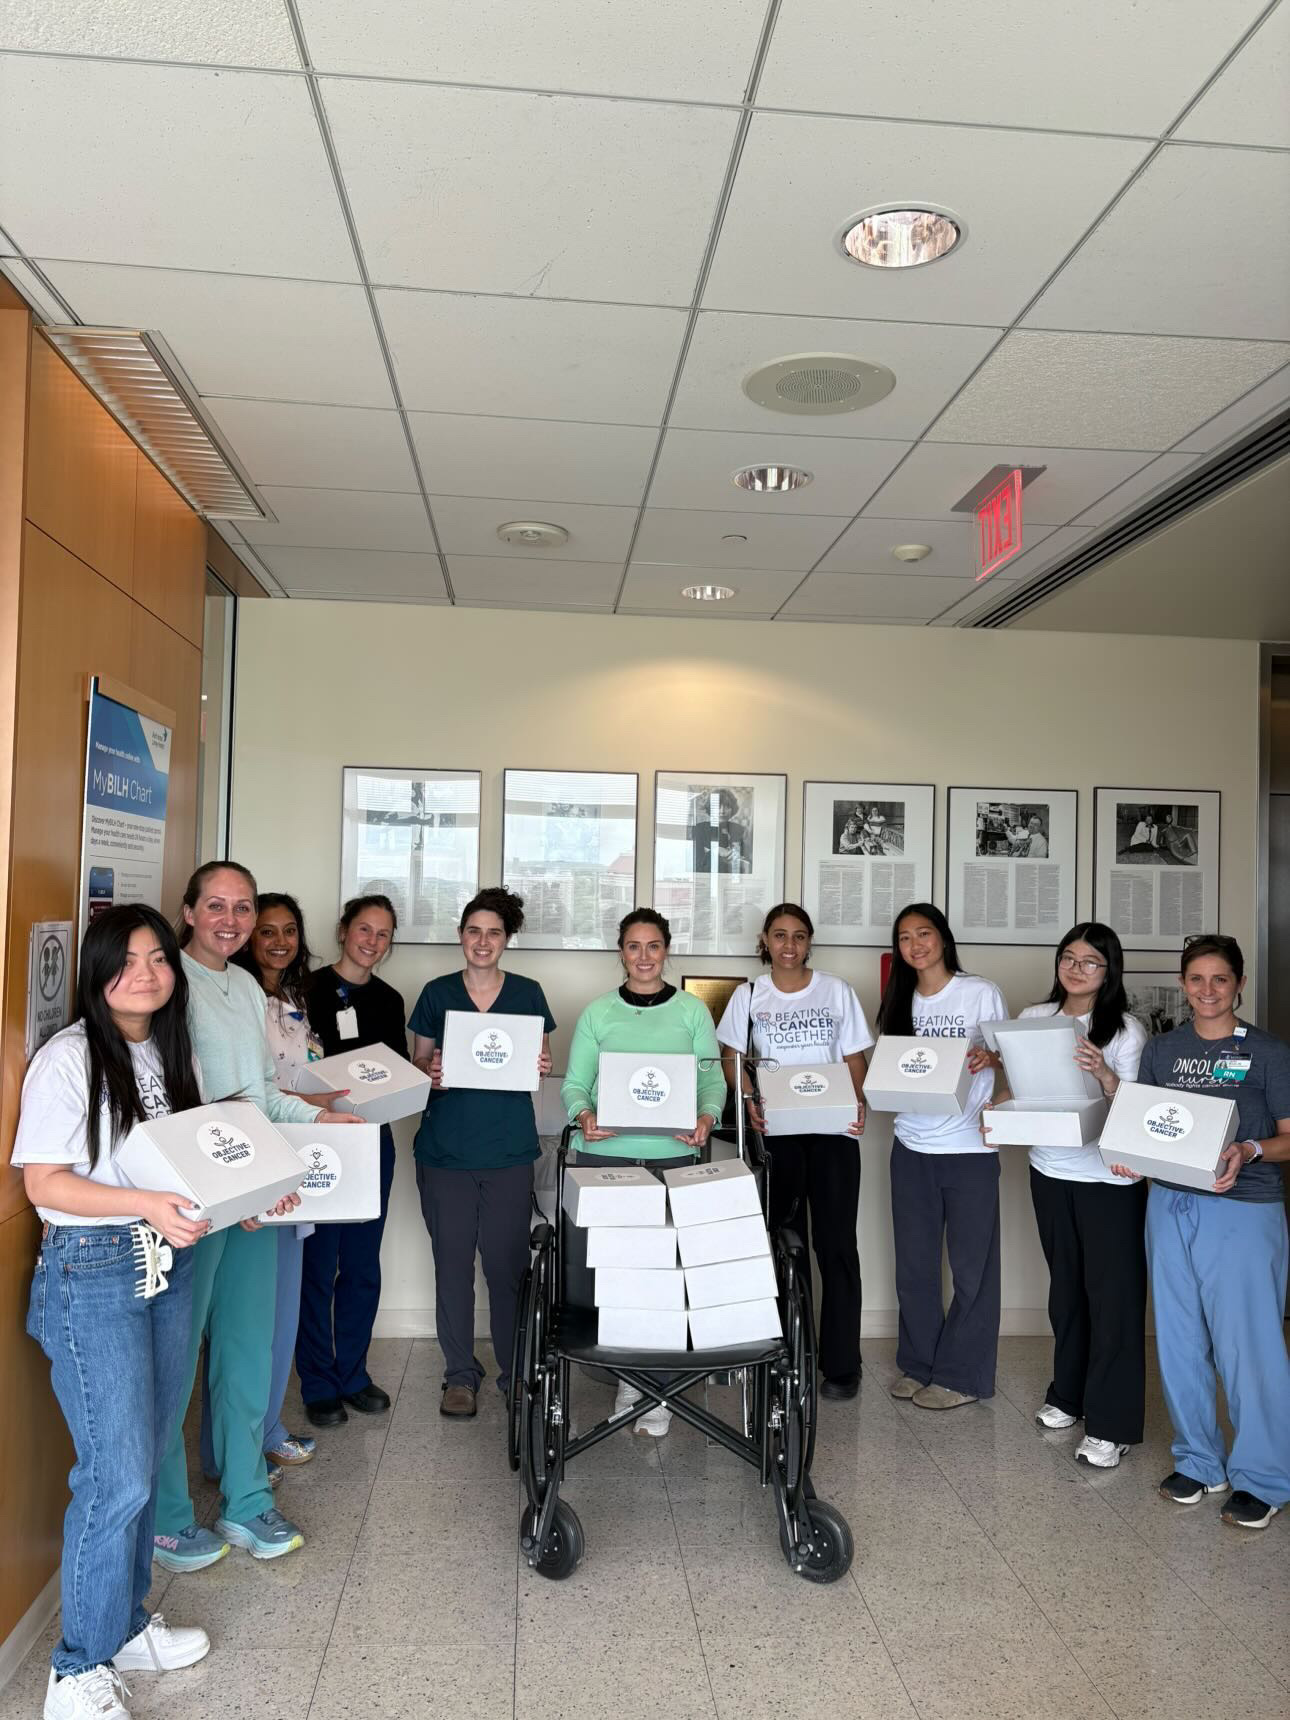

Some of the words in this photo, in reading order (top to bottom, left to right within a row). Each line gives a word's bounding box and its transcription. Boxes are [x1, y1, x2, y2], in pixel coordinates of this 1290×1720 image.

[93, 768, 129, 798] MyBILH
[130, 779, 153, 804] Chart
[775, 1007, 830, 1022] BEATING
[912, 1015, 964, 1027] BEATING
[779, 1017, 833, 1031] CANCER
[766, 1029, 833, 1044] TOGETHER
[480, 1056, 504, 1064] CANCER
[1172, 1058, 1219, 1076] ONCOL
[1150, 1126, 1178, 1138] CANCER
[211, 1142, 251, 1159] OBJECTIVE:
[222, 1149, 251, 1164] CANCER
[302, 1180, 331, 1188] CANCER
[303, 1173, 337, 1181] JECTIVE:
